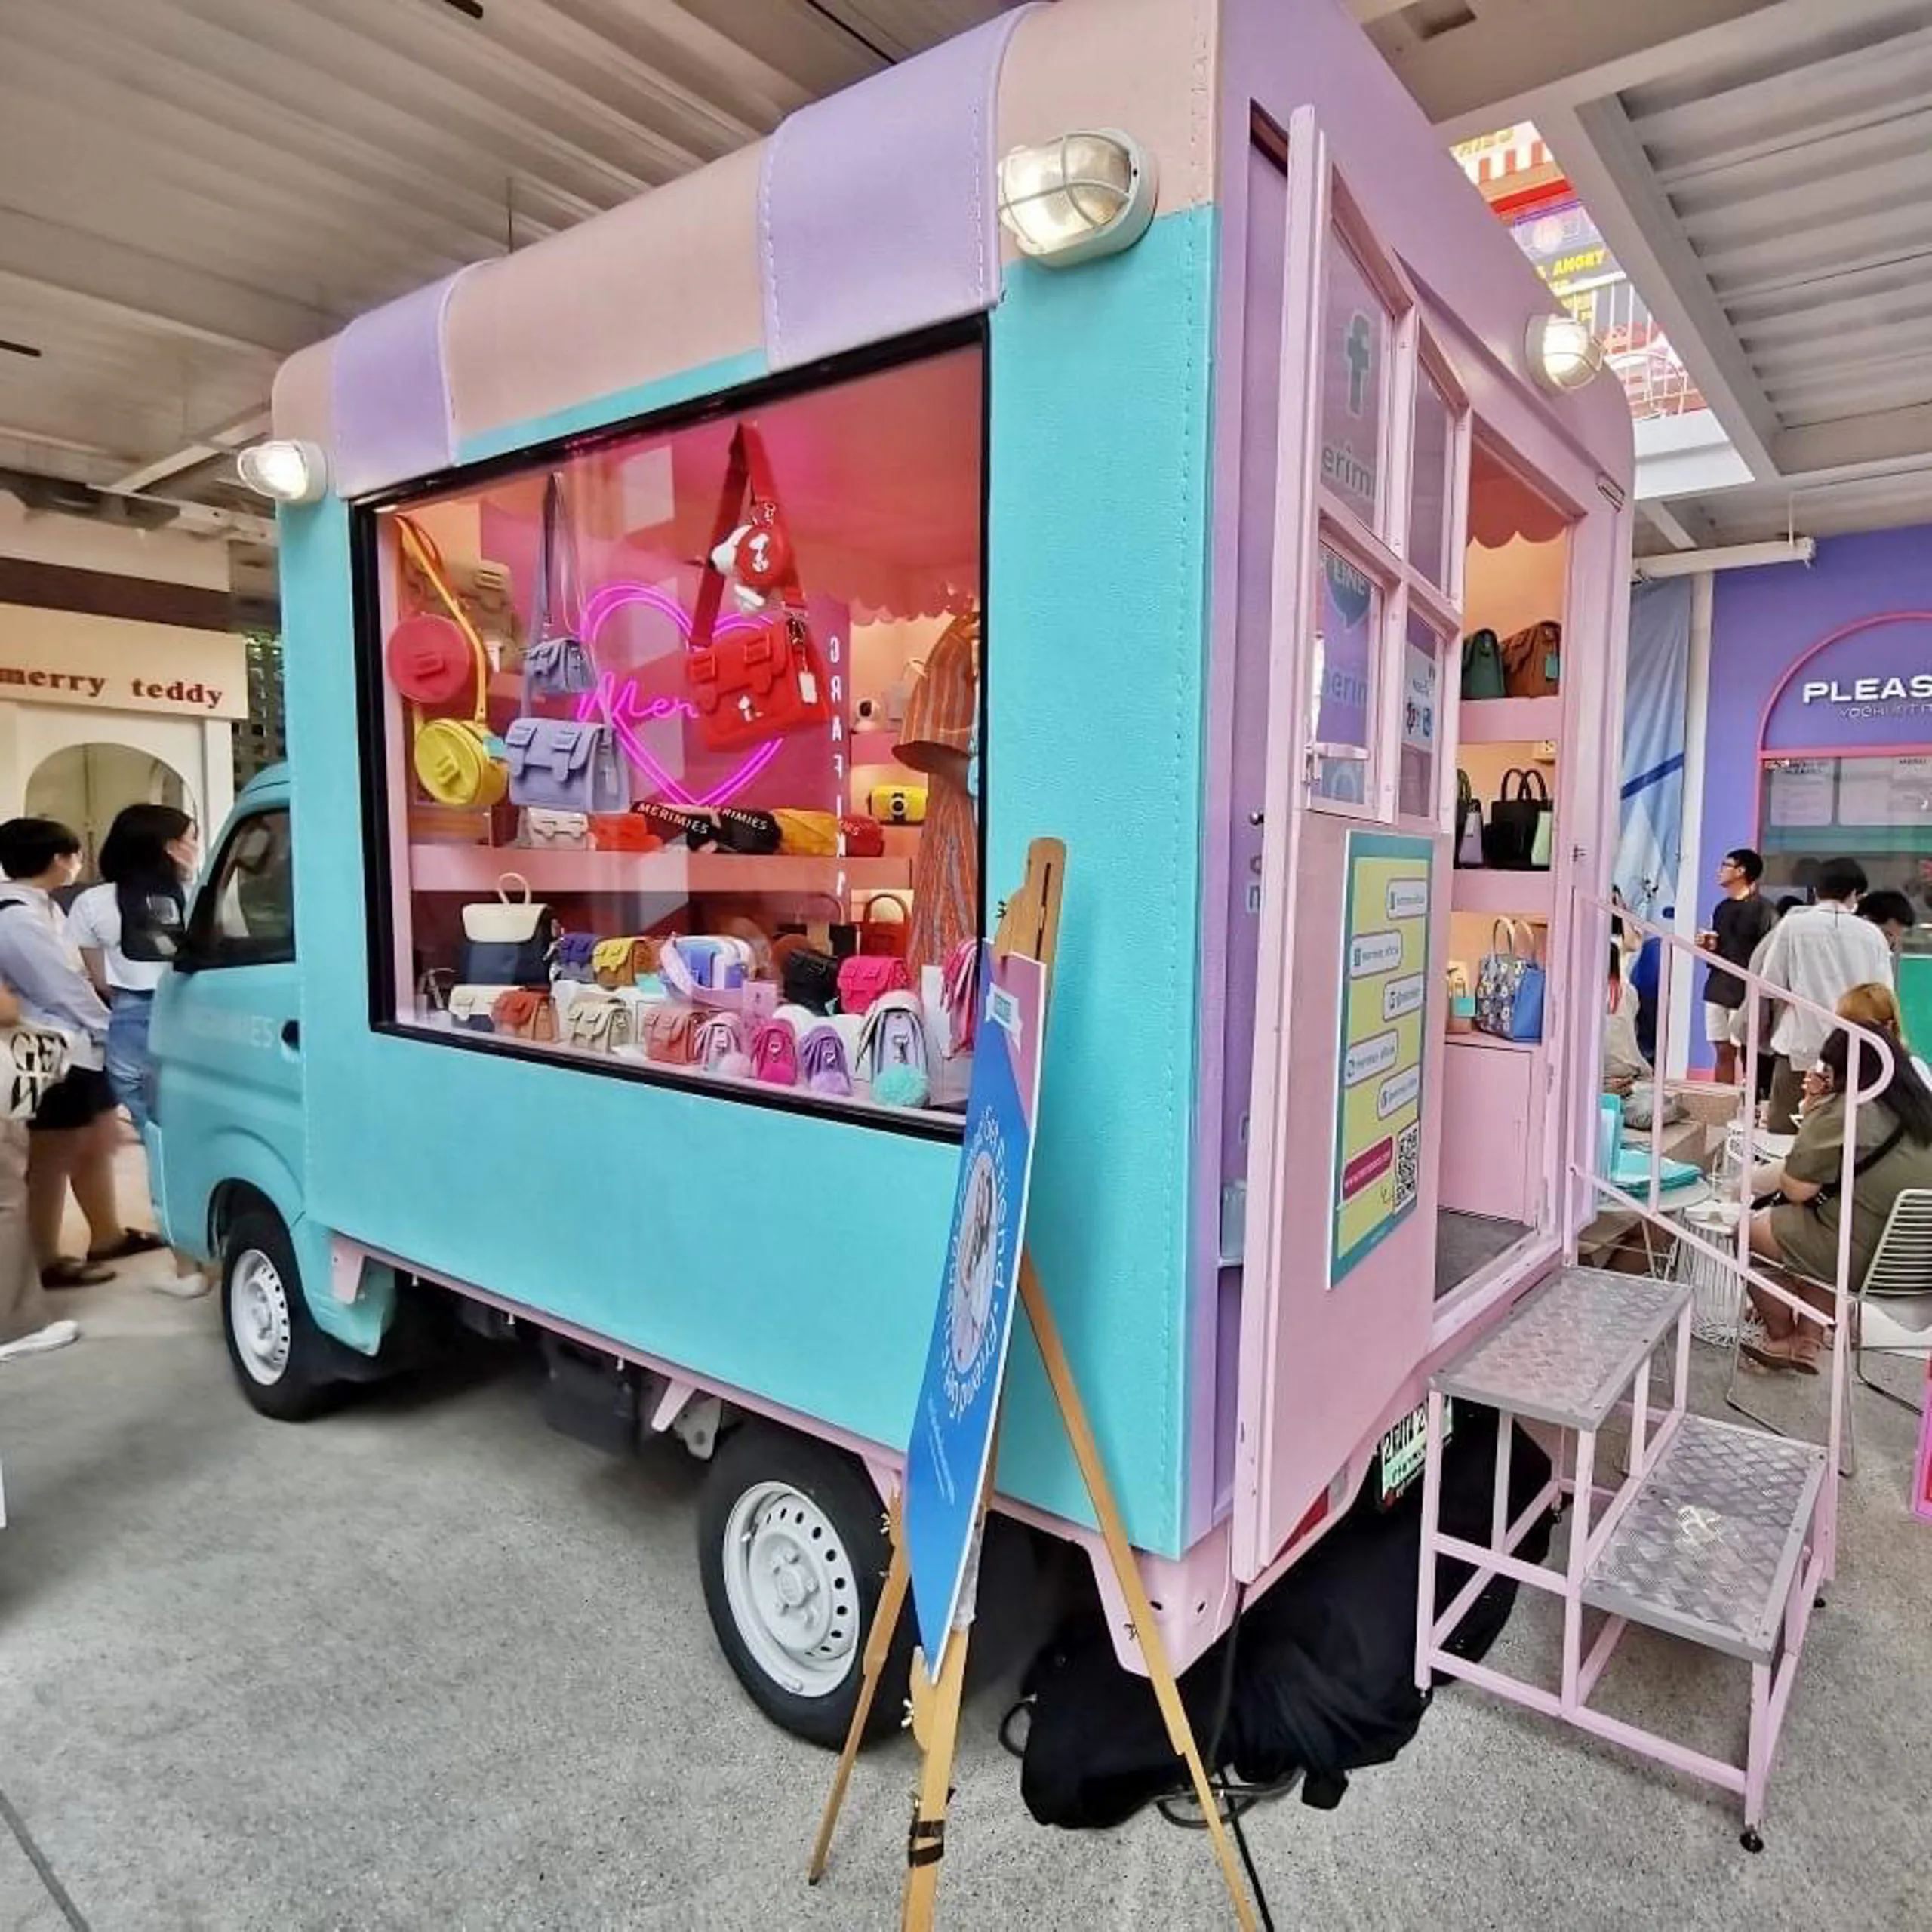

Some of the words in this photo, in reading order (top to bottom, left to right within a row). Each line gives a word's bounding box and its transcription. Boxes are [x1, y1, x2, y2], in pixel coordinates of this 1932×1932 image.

[131, 678, 223, 709] teddy
[1803, 675, 1932, 703] PLEAS
[637, 802, 710, 835] MERIMIES
